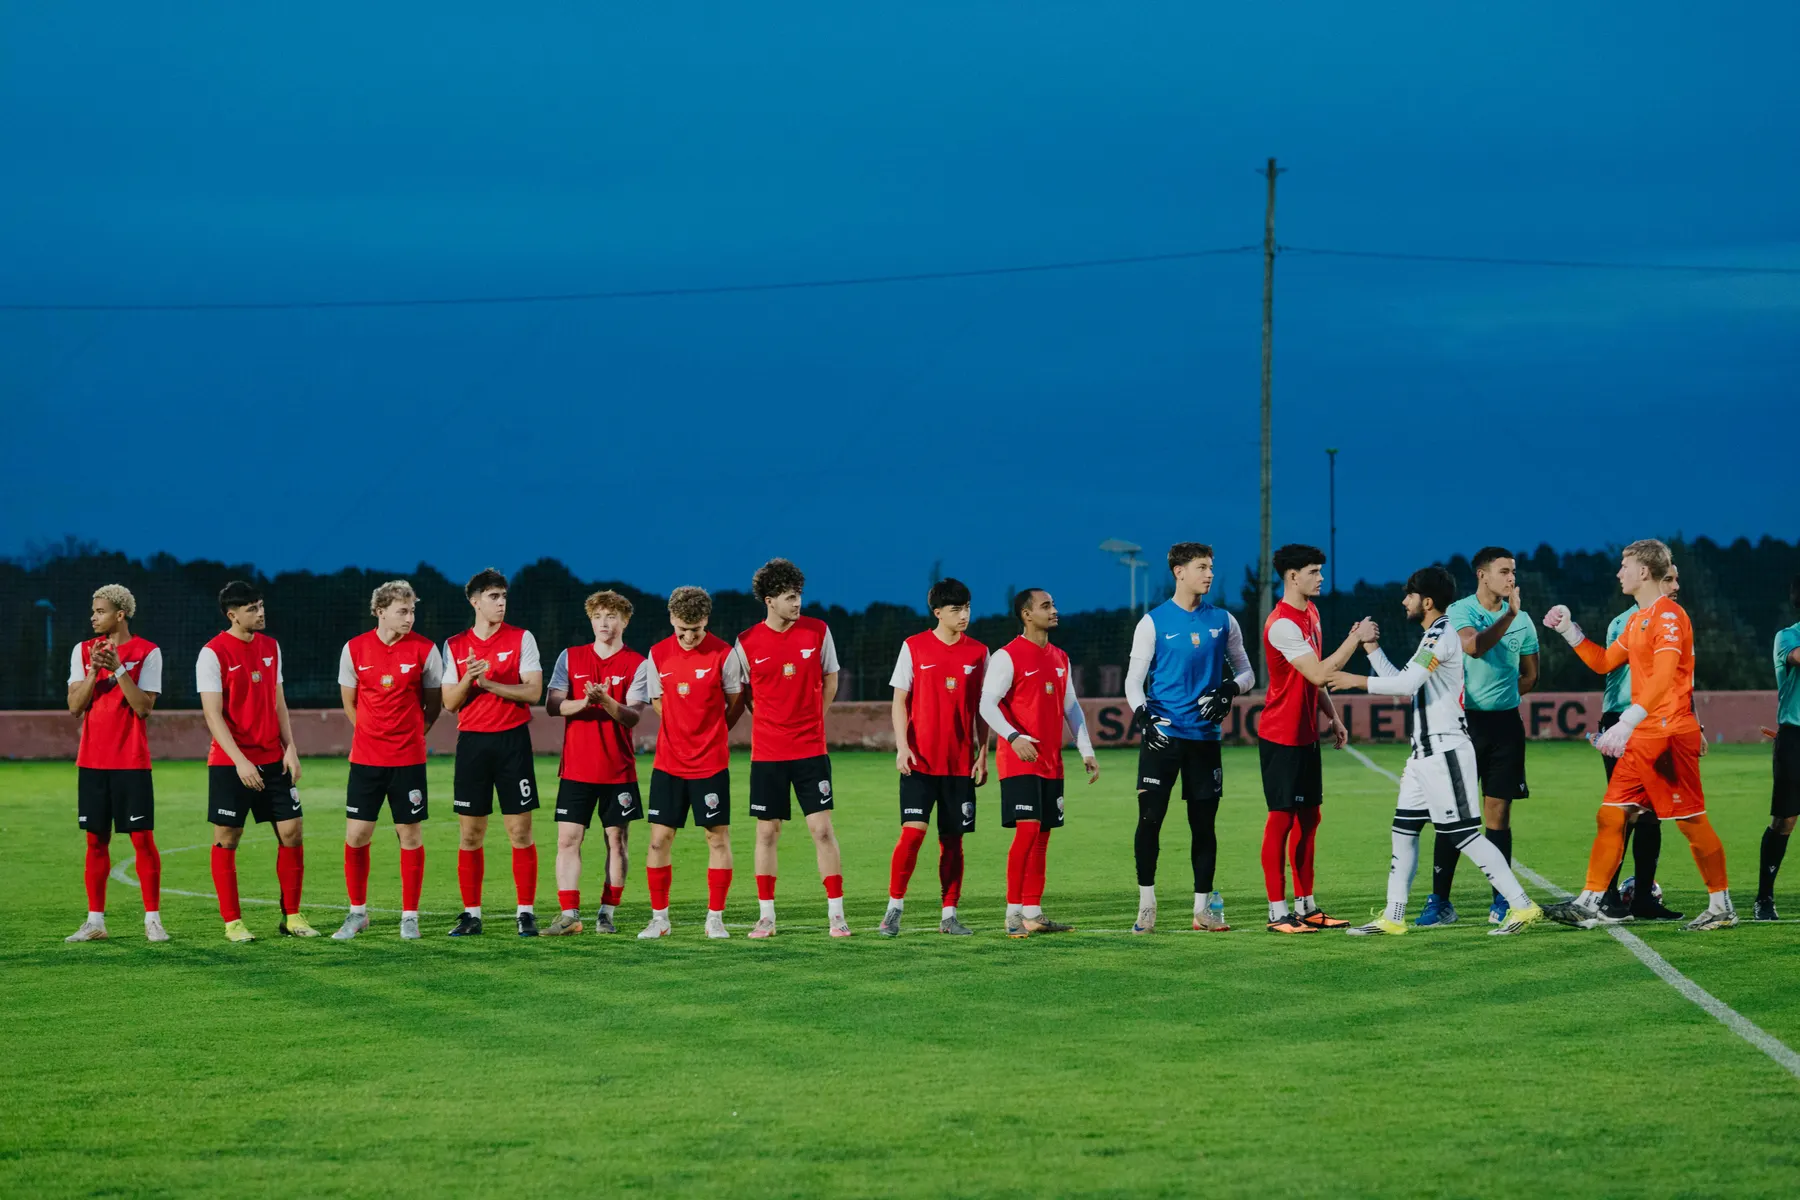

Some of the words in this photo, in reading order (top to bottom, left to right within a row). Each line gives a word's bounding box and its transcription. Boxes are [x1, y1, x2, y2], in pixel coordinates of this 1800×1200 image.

[1530, 701, 1587, 737] FC
[1142, 776, 1160, 786] ETURE
[519, 778, 531, 798] 6
[217, 808, 237, 818] ETURE
[1015, 804, 1034, 812] ETURE
